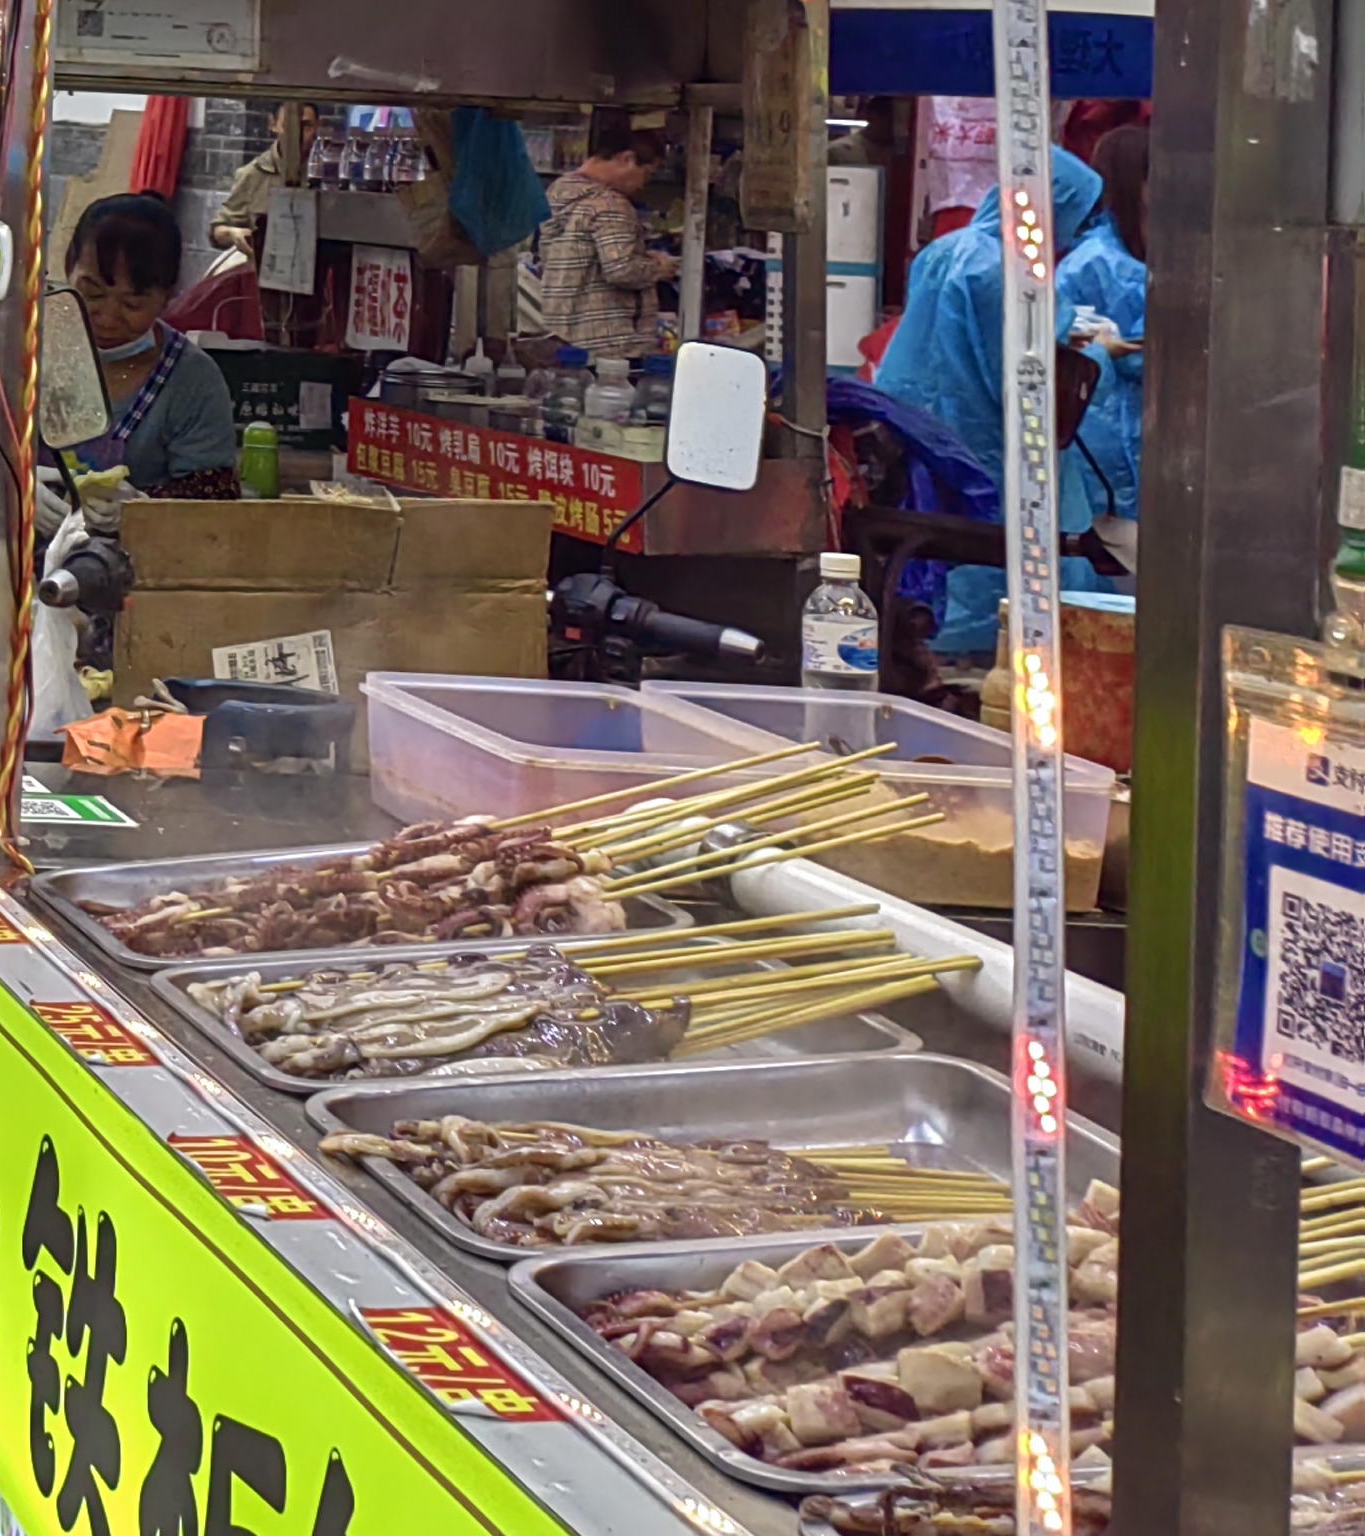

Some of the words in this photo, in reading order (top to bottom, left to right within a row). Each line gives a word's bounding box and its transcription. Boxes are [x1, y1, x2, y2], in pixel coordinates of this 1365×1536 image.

[406, 421, 434, 453] 10元
[439, 428, 481, 465] 烤乳扇
[487, 440, 520, 475] 10元
[527, 446, 575, 488] 烤饵块
[581, 461, 617, 498] 10元
